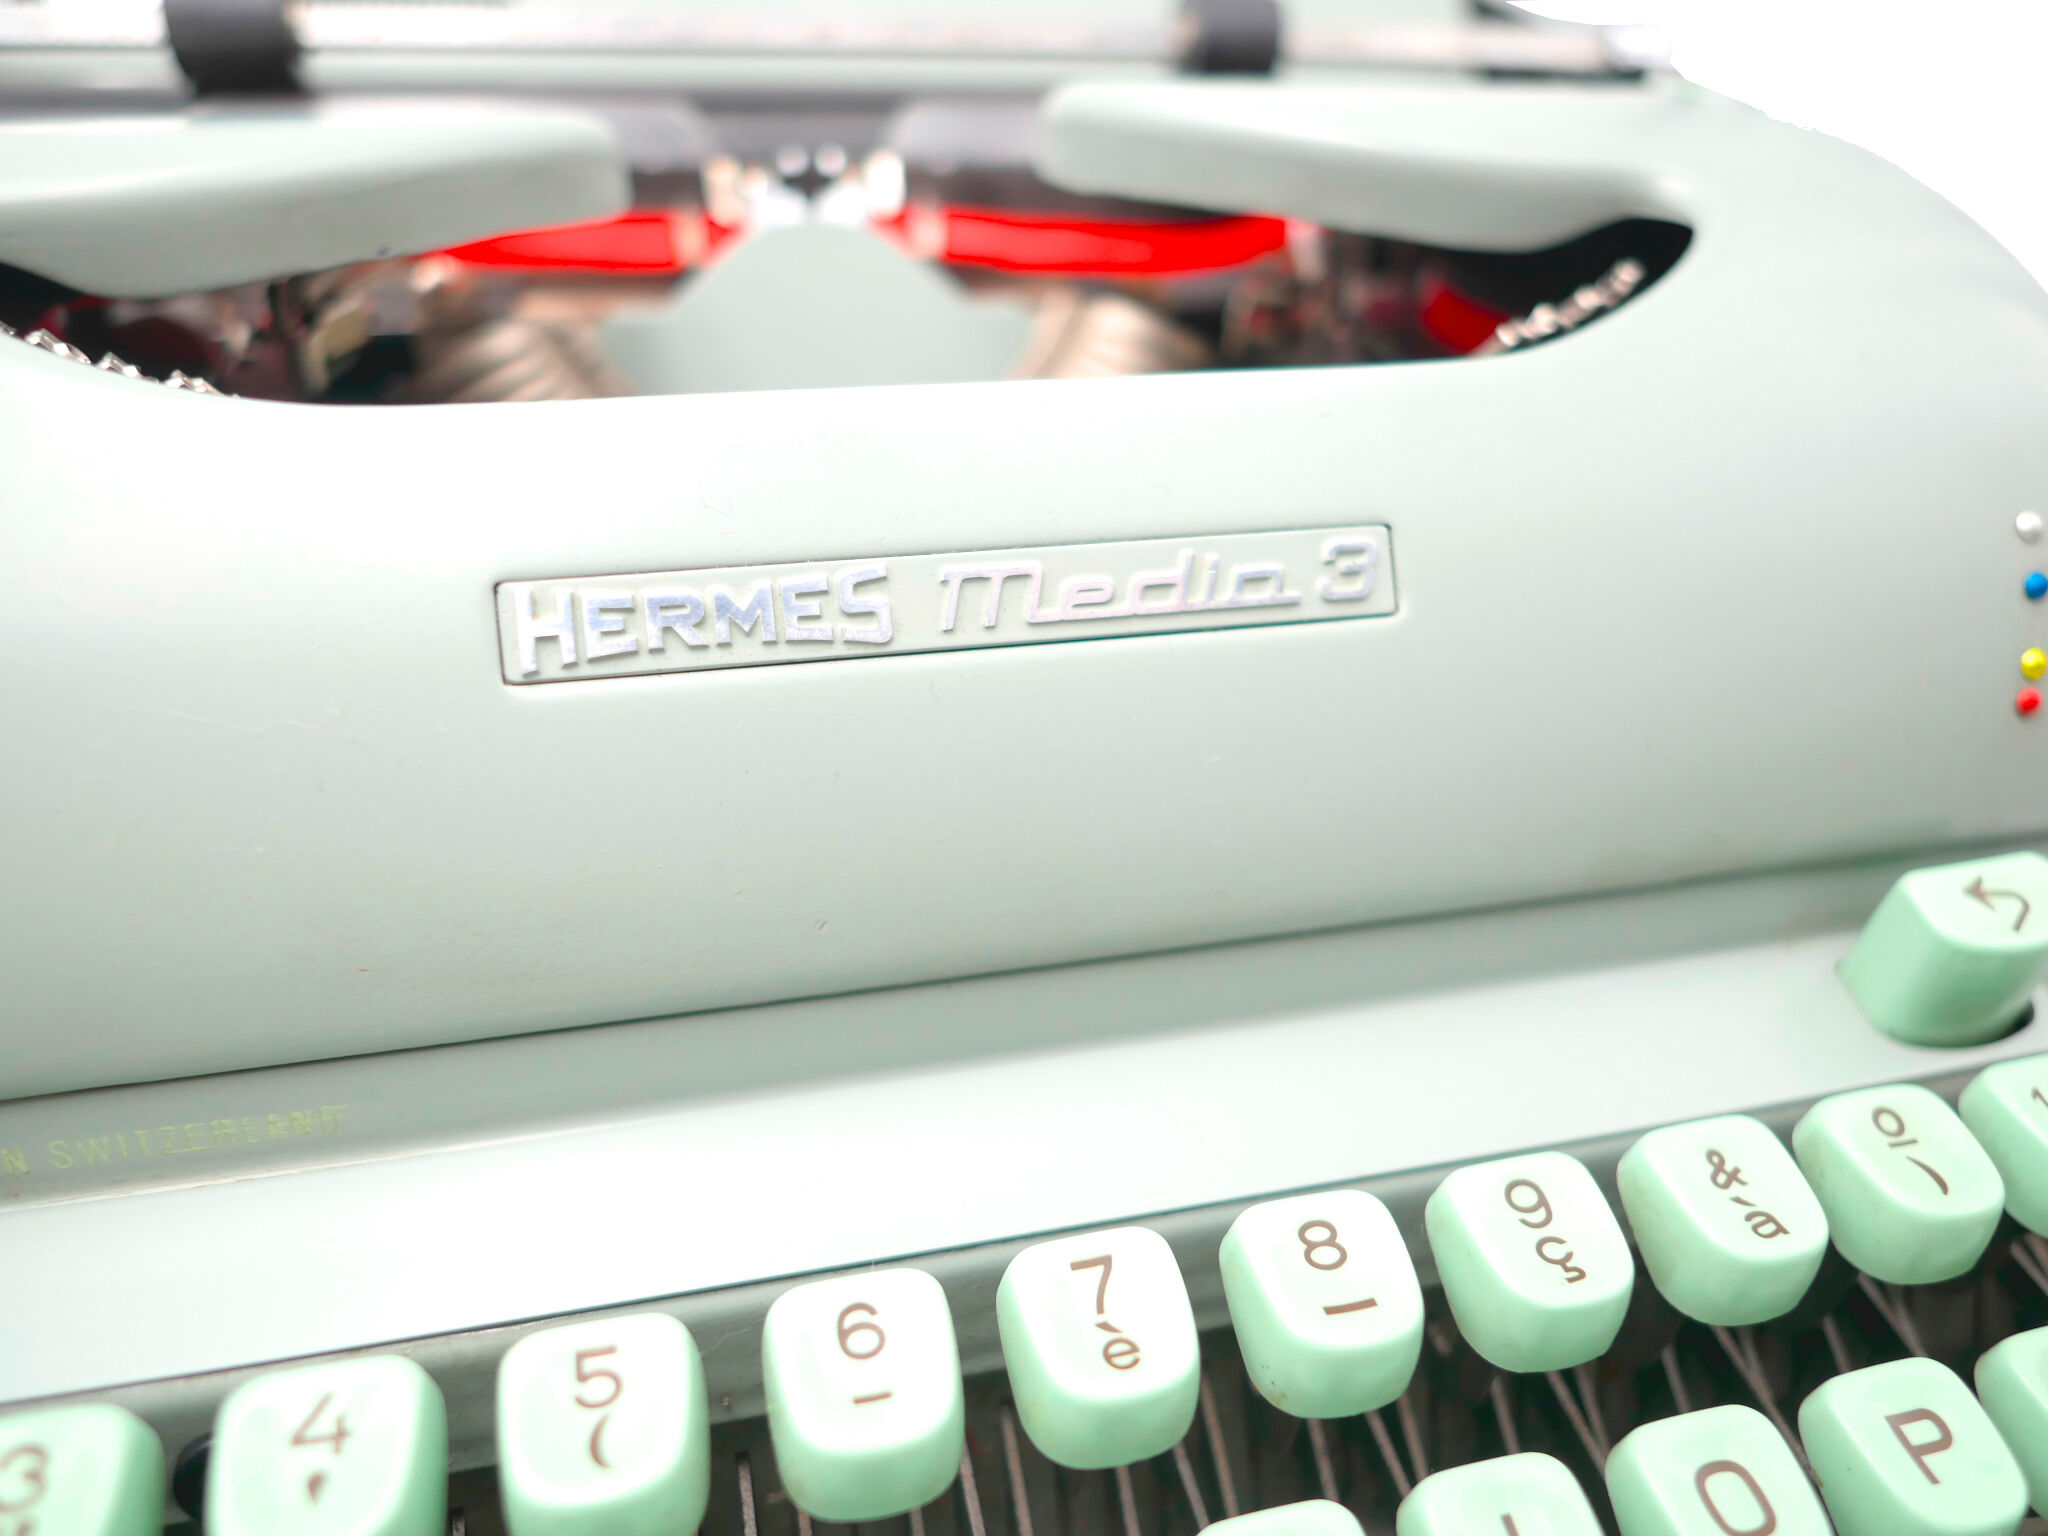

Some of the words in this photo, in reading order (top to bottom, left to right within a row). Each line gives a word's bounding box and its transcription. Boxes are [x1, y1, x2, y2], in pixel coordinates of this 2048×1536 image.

[512, 562, 894, 678] HERMES
[937, 546, 1302, 634] Media
[1315, 535, 1379, 603] 3
[1705, 1148, 1748, 1190] &
[1504, 1179, 1553, 1229] 9
[1297, 1219, 1348, 1271] 8
[1535, 1236, 1587, 1284] ç
[1070, 1254, 1113, 1315] 7
[836, 1302, 886, 1361] 6
[574, 1346, 623, 1409] 5
[290, 1392, 353, 1456] 4
[1884, 1406, 1954, 1486] P
